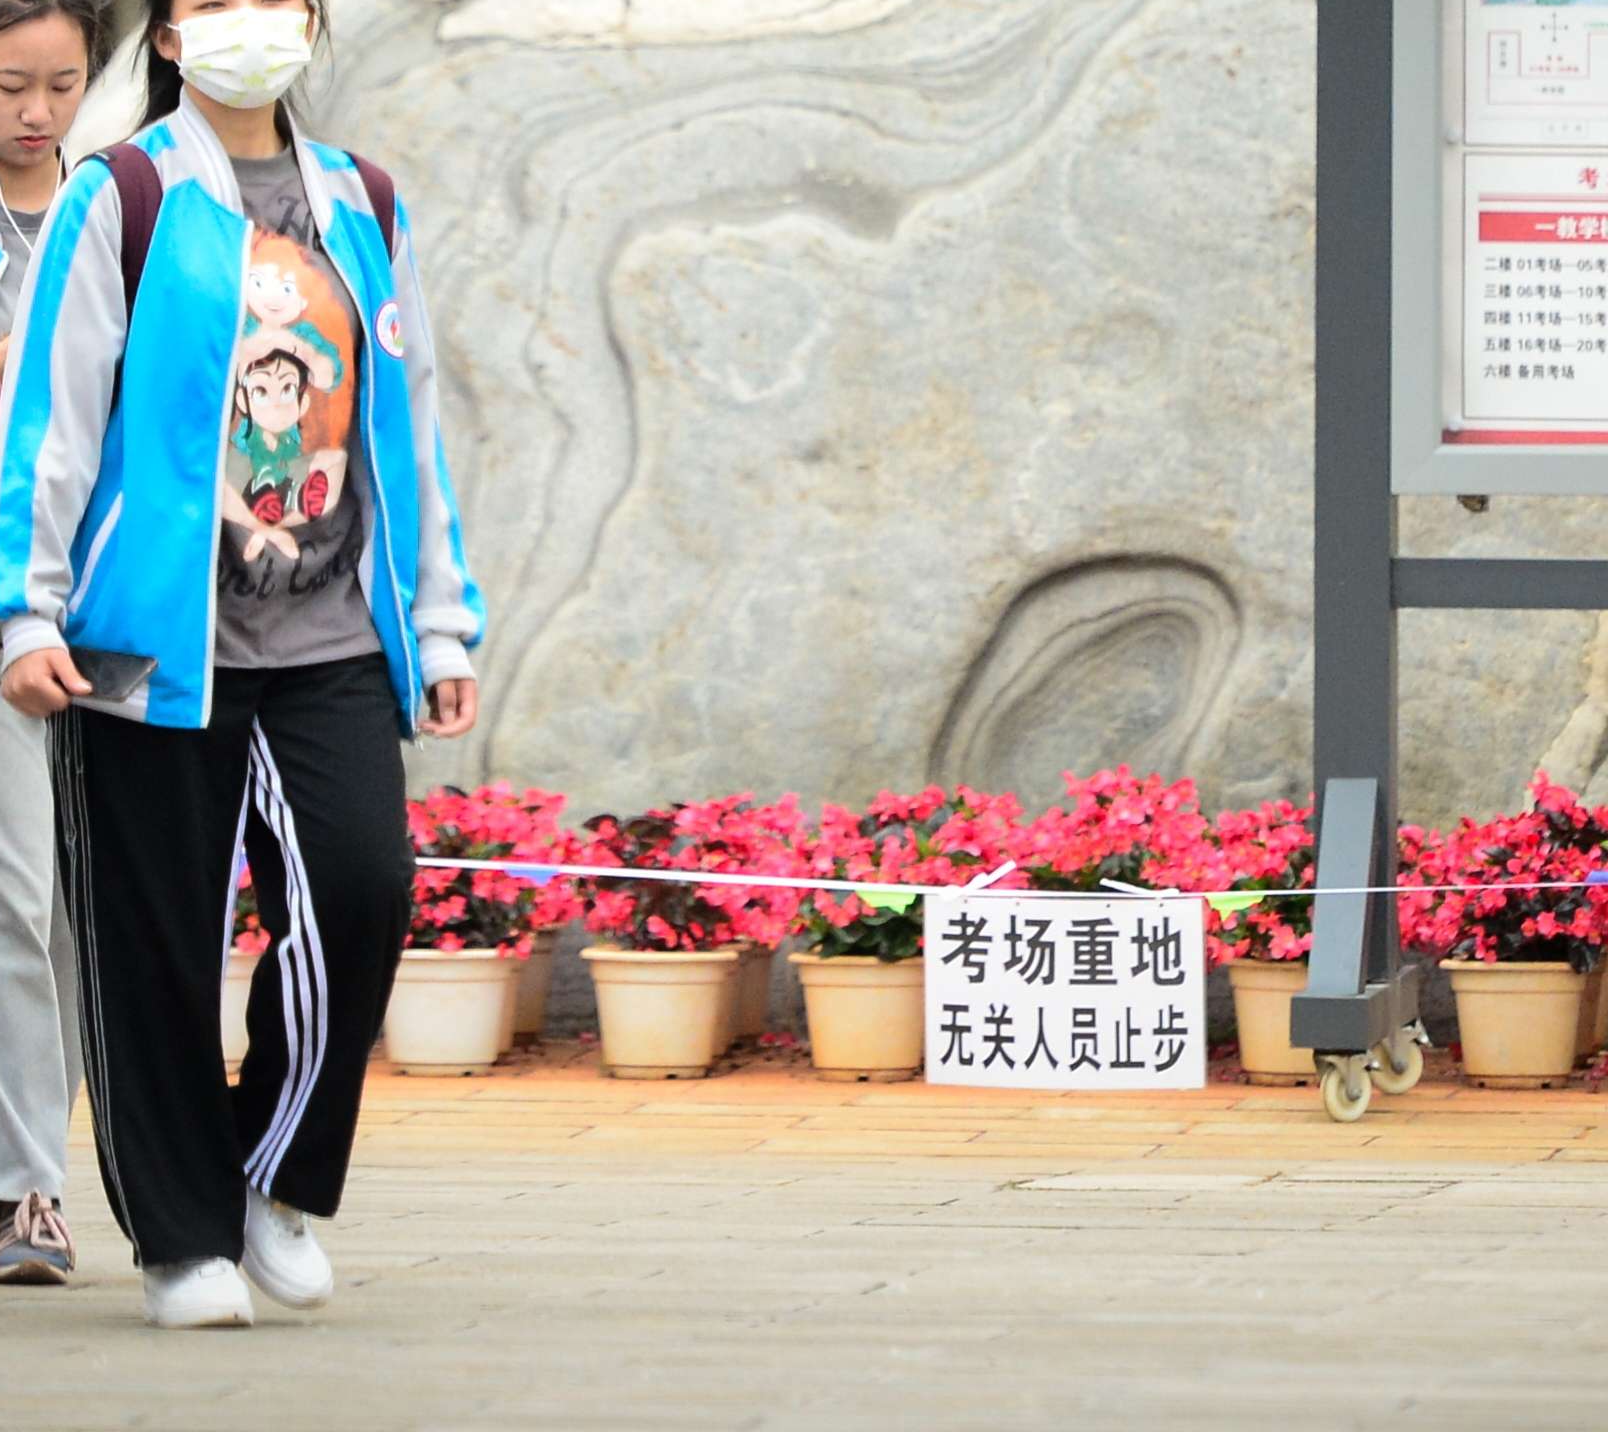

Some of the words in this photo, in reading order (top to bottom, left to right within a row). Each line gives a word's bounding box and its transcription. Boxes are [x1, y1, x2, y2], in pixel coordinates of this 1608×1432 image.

[941, 912, 1186, 986] 考场重地
[940, 1002, 1189, 1072] 无关人员止步
